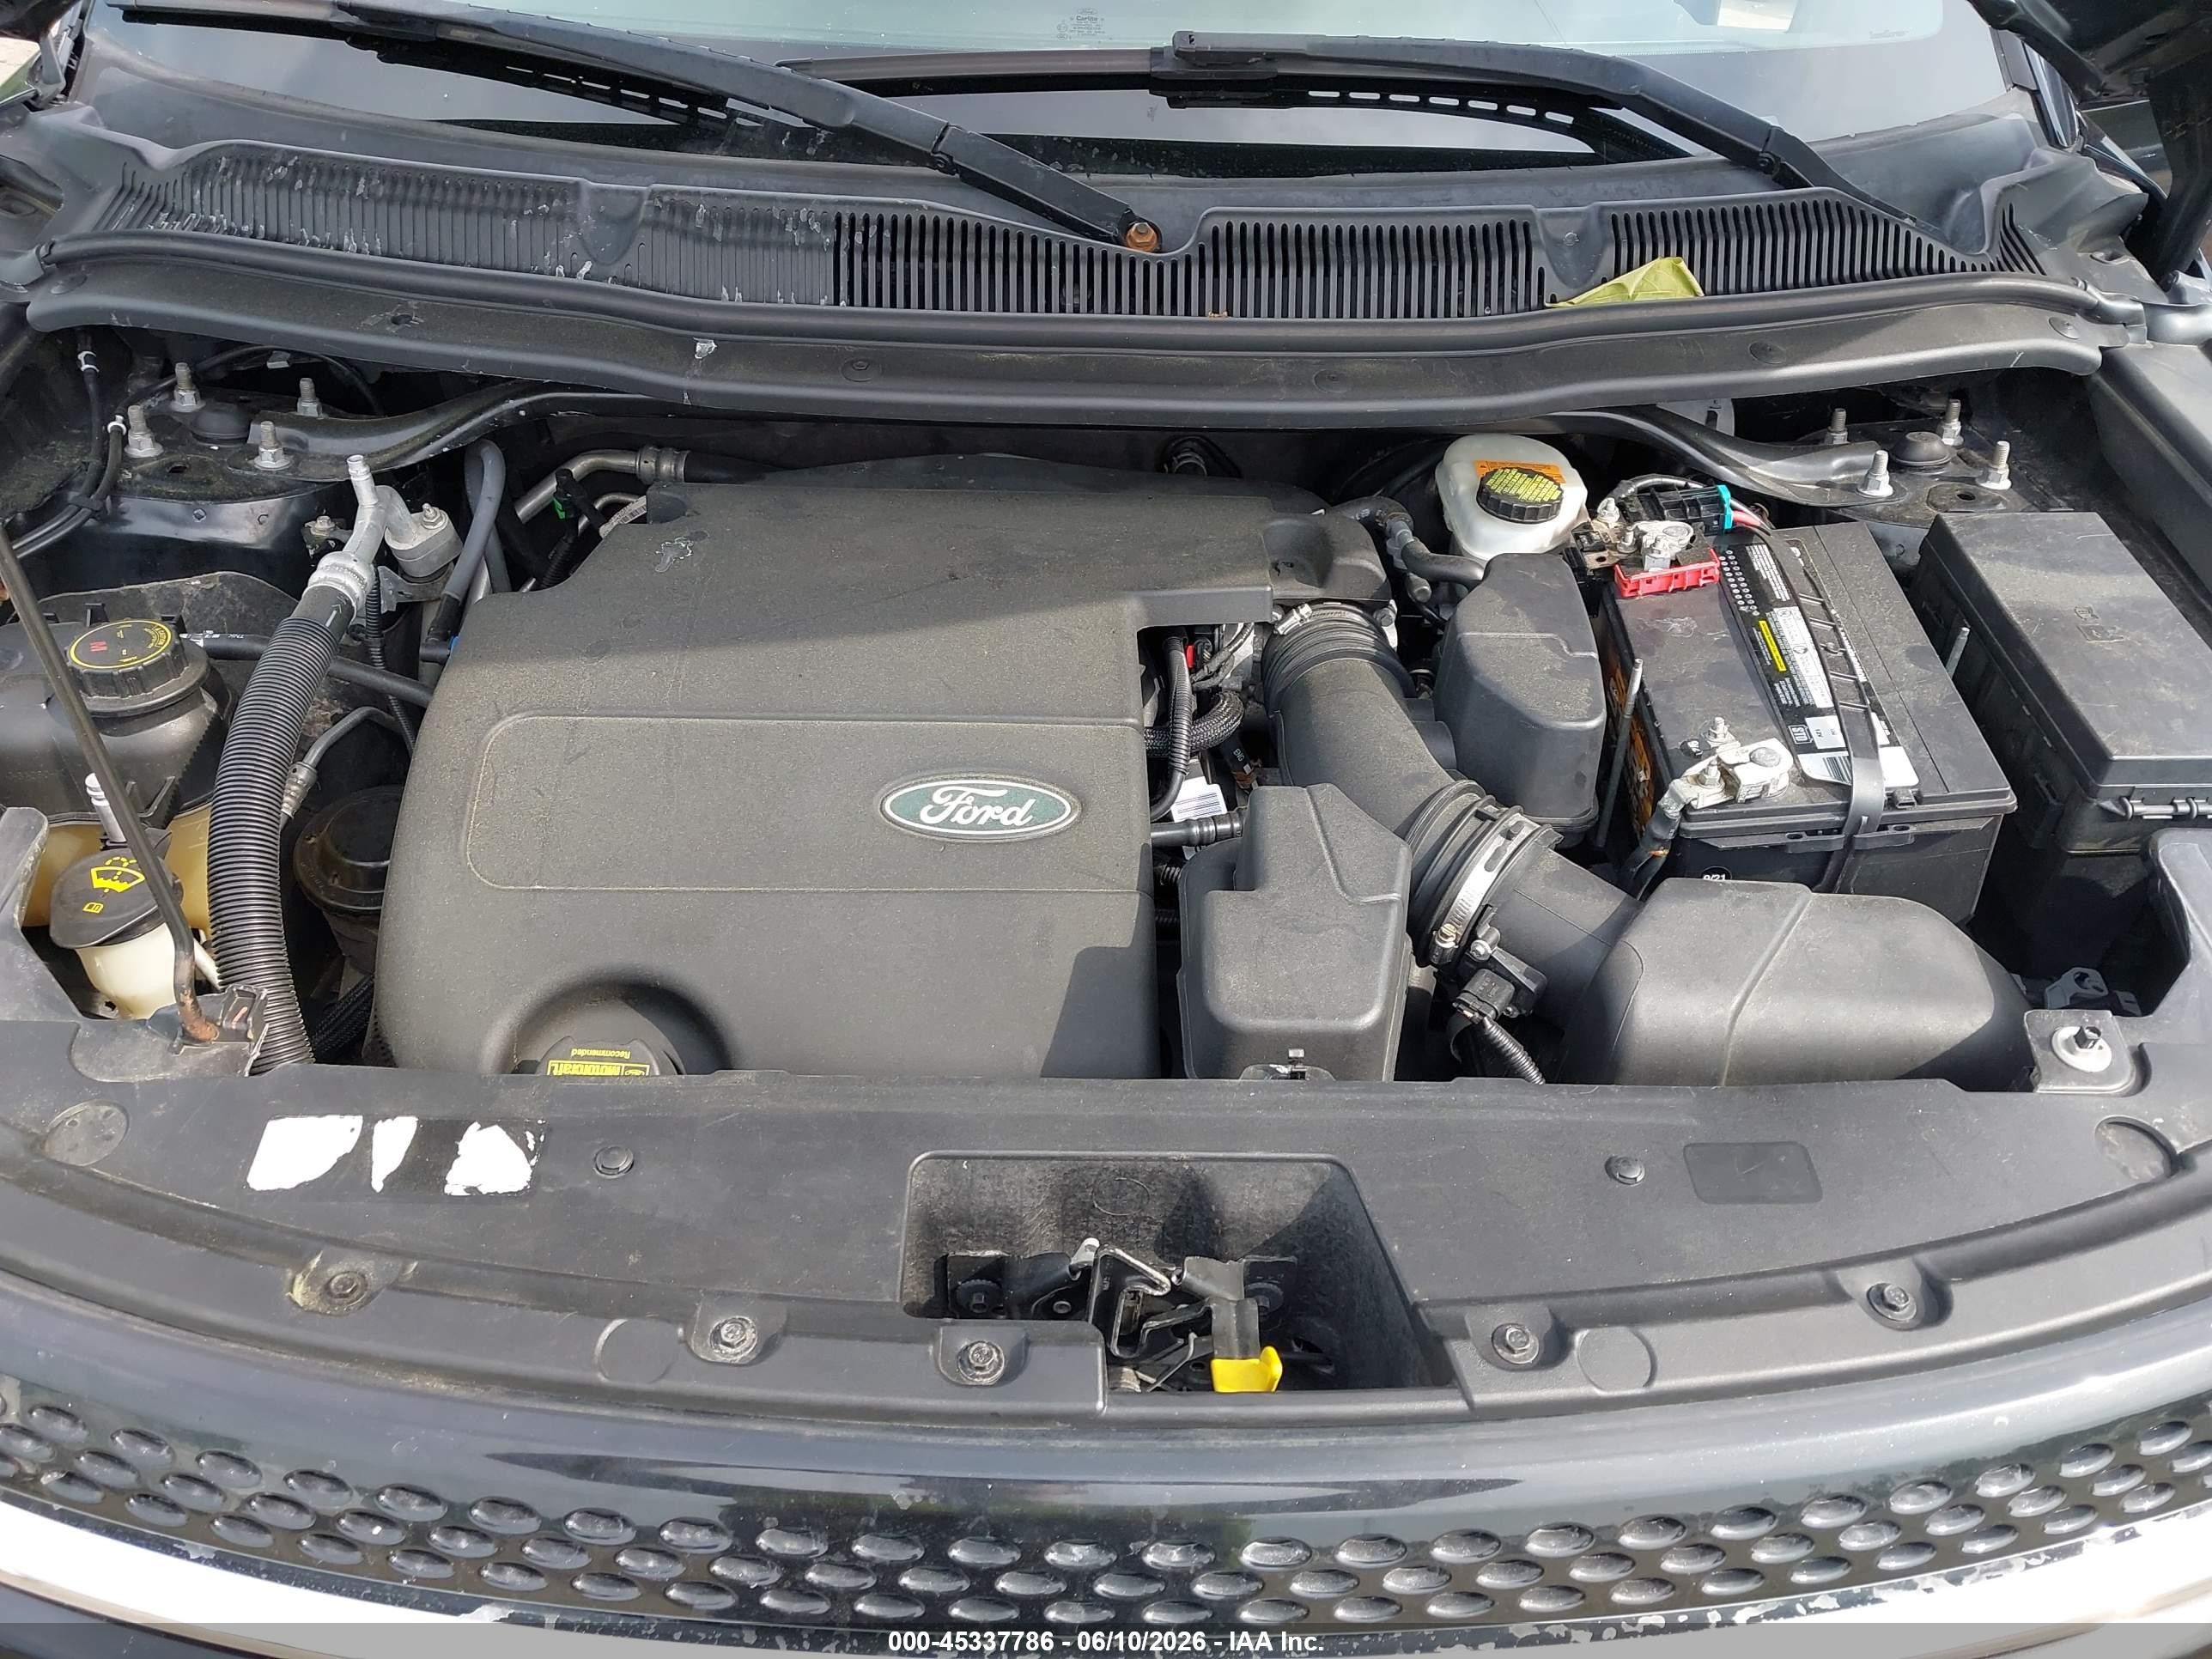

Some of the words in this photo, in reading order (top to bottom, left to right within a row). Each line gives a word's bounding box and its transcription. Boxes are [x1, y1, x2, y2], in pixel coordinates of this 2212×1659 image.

[1233, 748, 1245, 762] ENG
[920, 786, 1036, 826] Ford
[571, 1048, 631, 1060] Recommended
